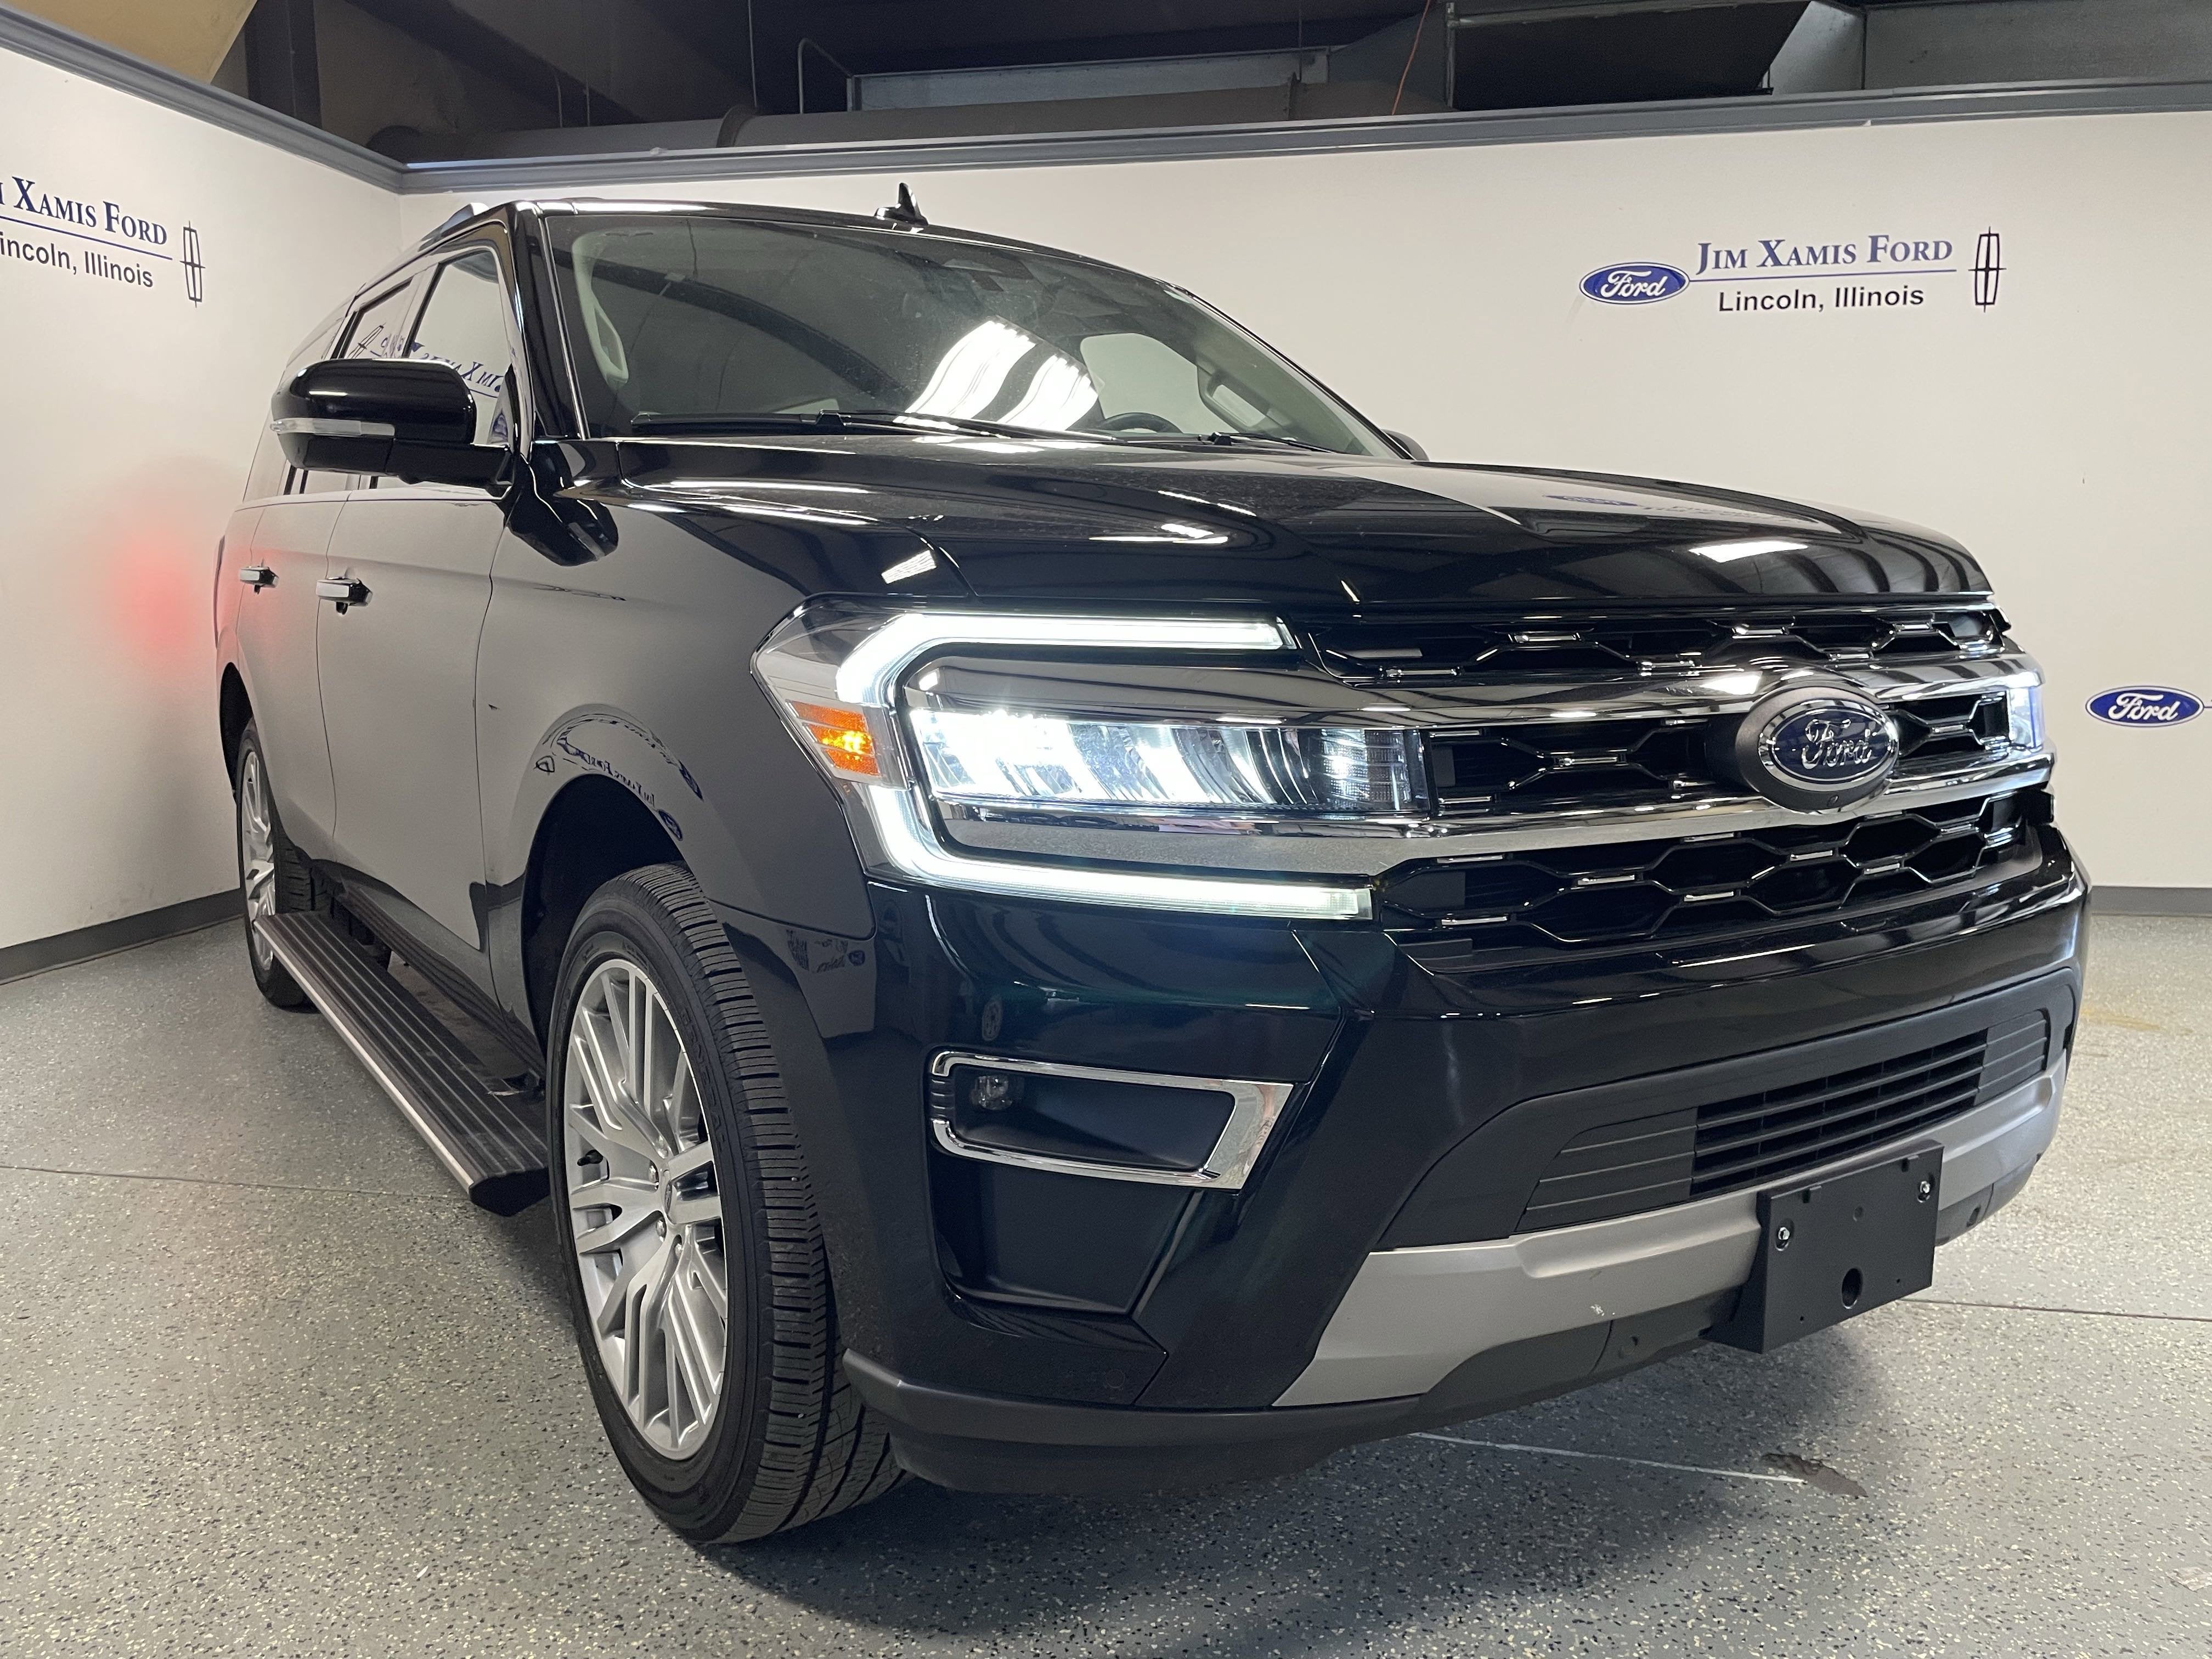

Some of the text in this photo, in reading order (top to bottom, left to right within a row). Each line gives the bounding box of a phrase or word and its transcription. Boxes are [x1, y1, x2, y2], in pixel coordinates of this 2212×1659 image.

[103, 200, 167, 245] FORD
[0, 231, 153, 287] incoln, Illinois
[1695, 242, 1748, 275] JIM
[1866, 234, 1953, 263] FORD
[1600, 270, 1668, 298] Ford
[1719, 284, 1925, 312] Lincoln, Illinois
[2108, 692, 2181, 721] Ford
[1802, 718, 1873, 770] Ford
